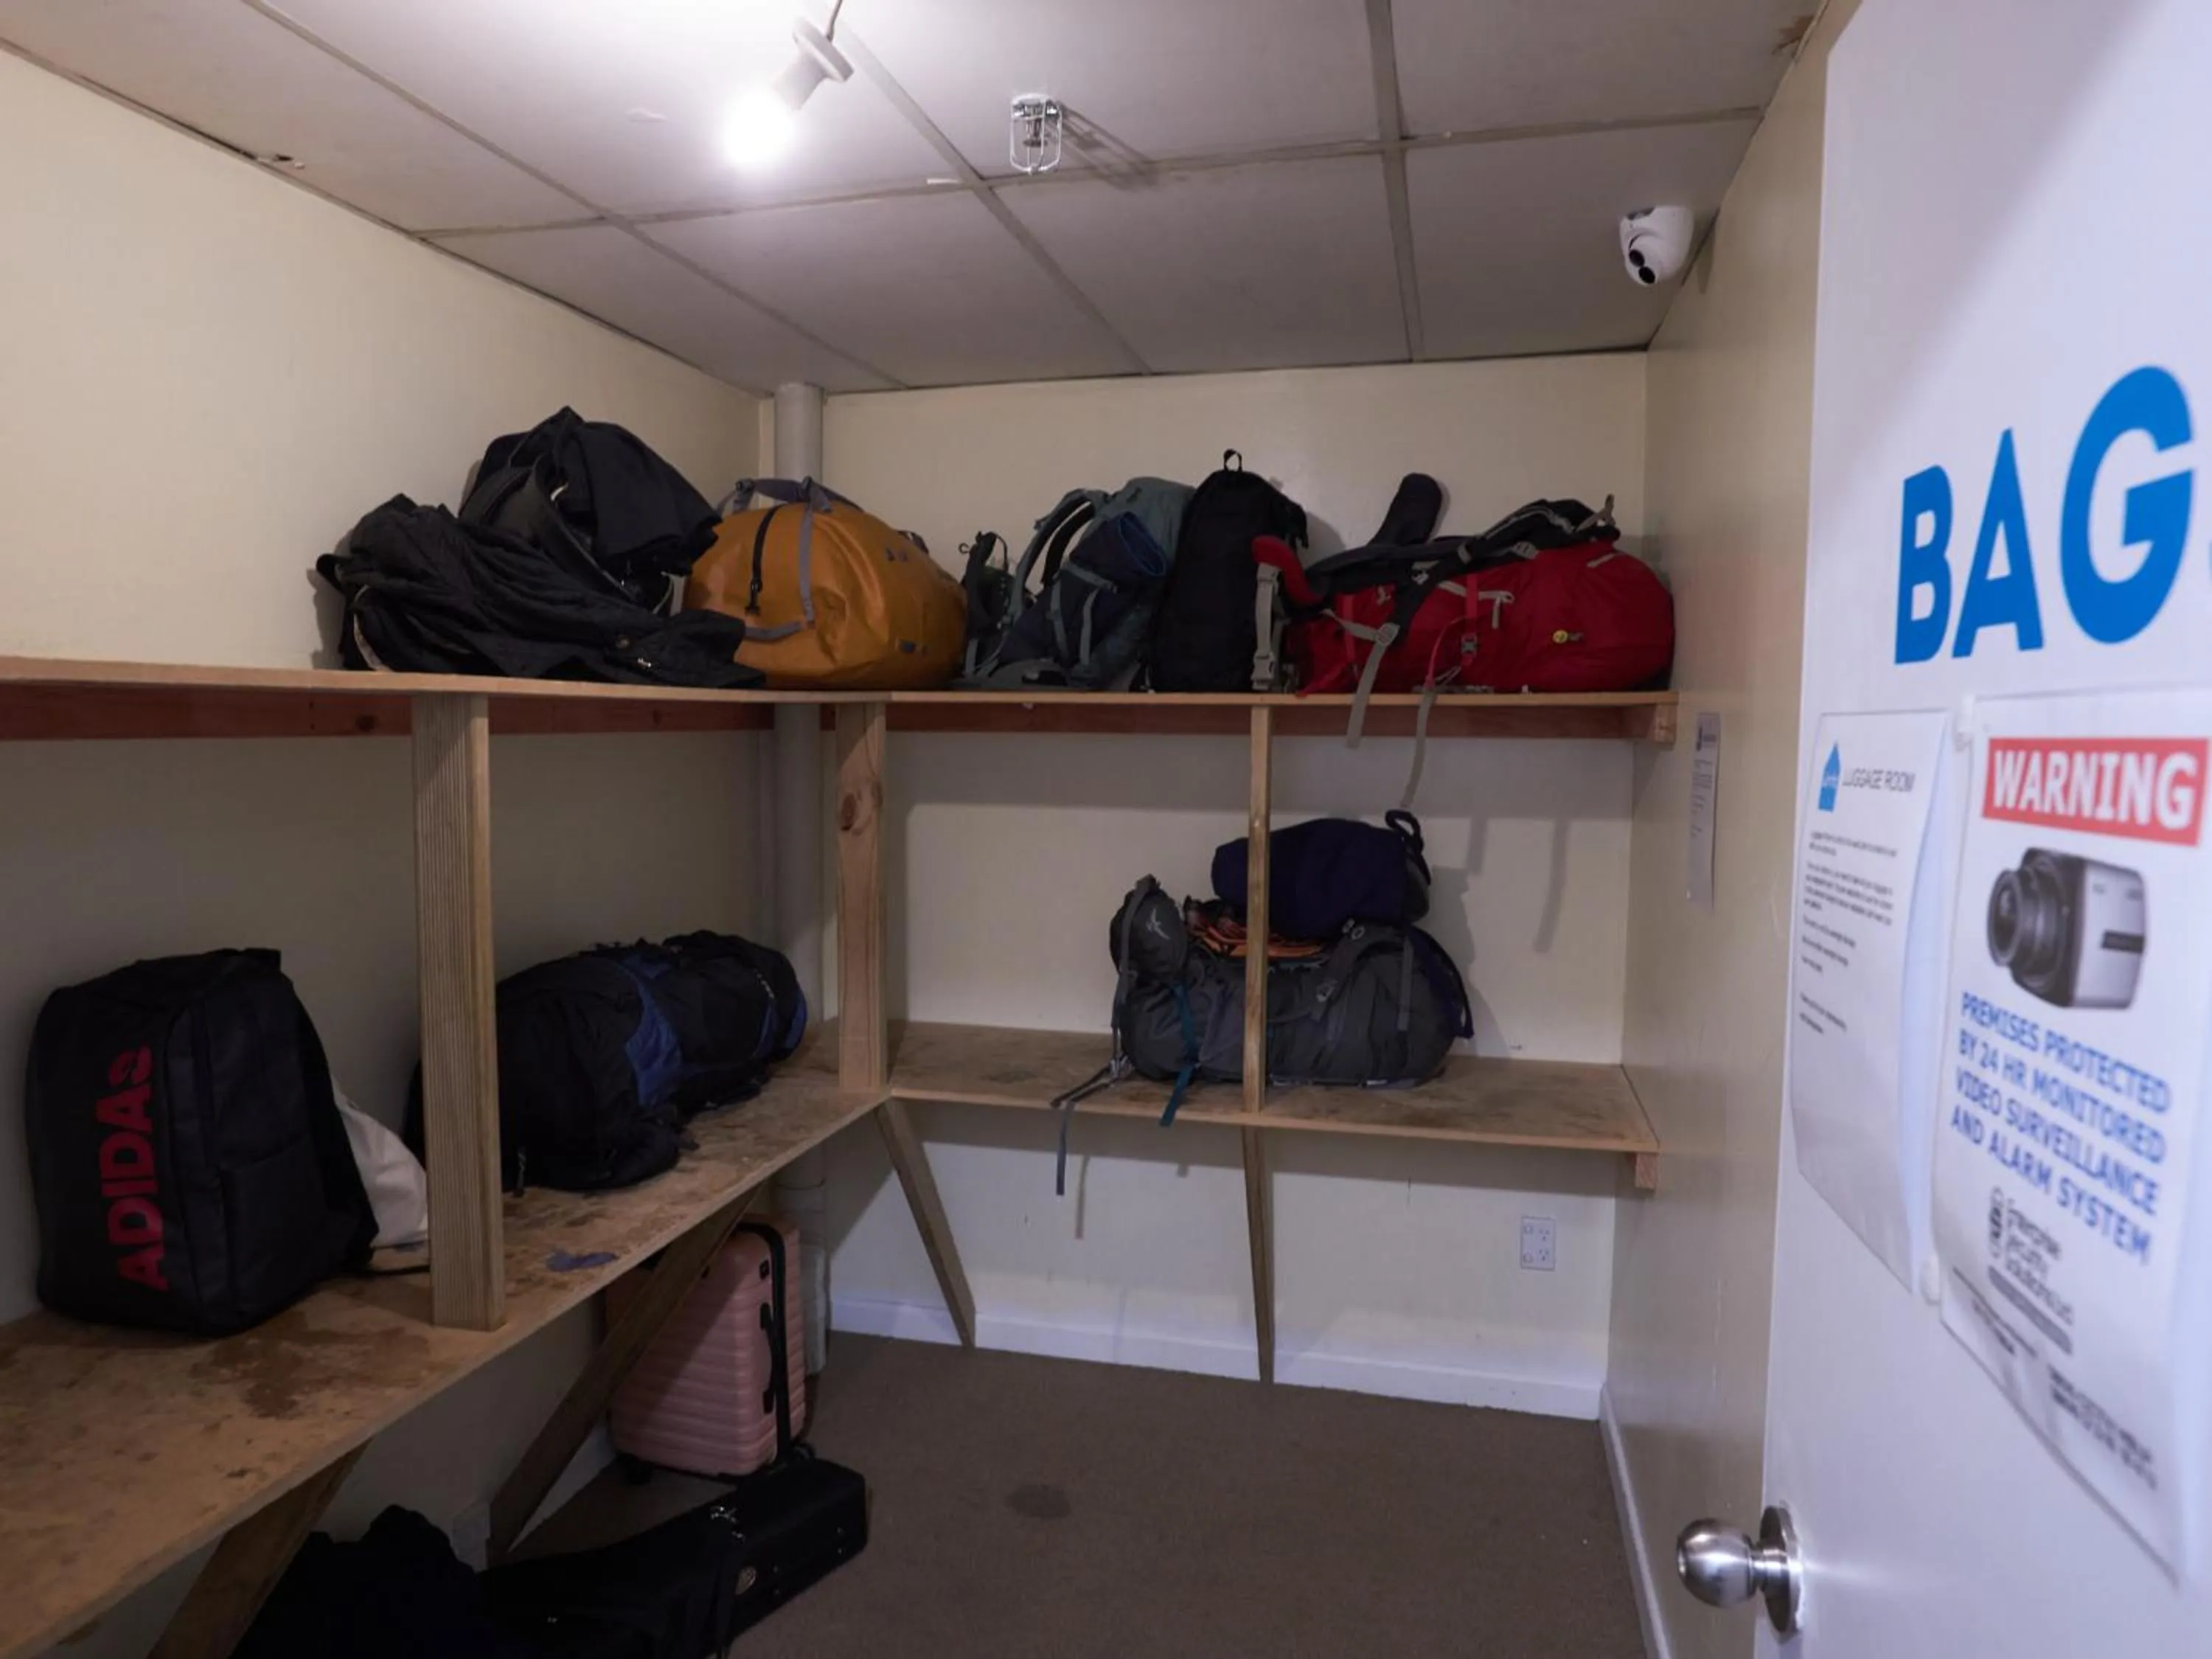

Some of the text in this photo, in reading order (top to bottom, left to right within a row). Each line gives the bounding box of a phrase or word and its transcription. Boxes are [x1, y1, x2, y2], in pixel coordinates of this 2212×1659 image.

[1896, 366, 2212, 664] BAG
[1843, 768, 1884, 790] LUGGAGE
[1886, 770, 1916, 792] ROOM
[1994, 749, 2197, 830] WARNING
[1959, 1028, 2166, 1164] BY 24 HR MONITORED
[1962, 991, 2170, 1113] PREMISES PROTECTED
[96, 1046, 167, 1291] ADIDAS
[1951, 1105, 1985, 1145] AND
[1988, 1129, 2052, 1194] ALARM
[2056, 1176, 2151, 1265] SYSTEM
[1956, 1066, 2158, 1216] VIDEO SURVEILLANCE
